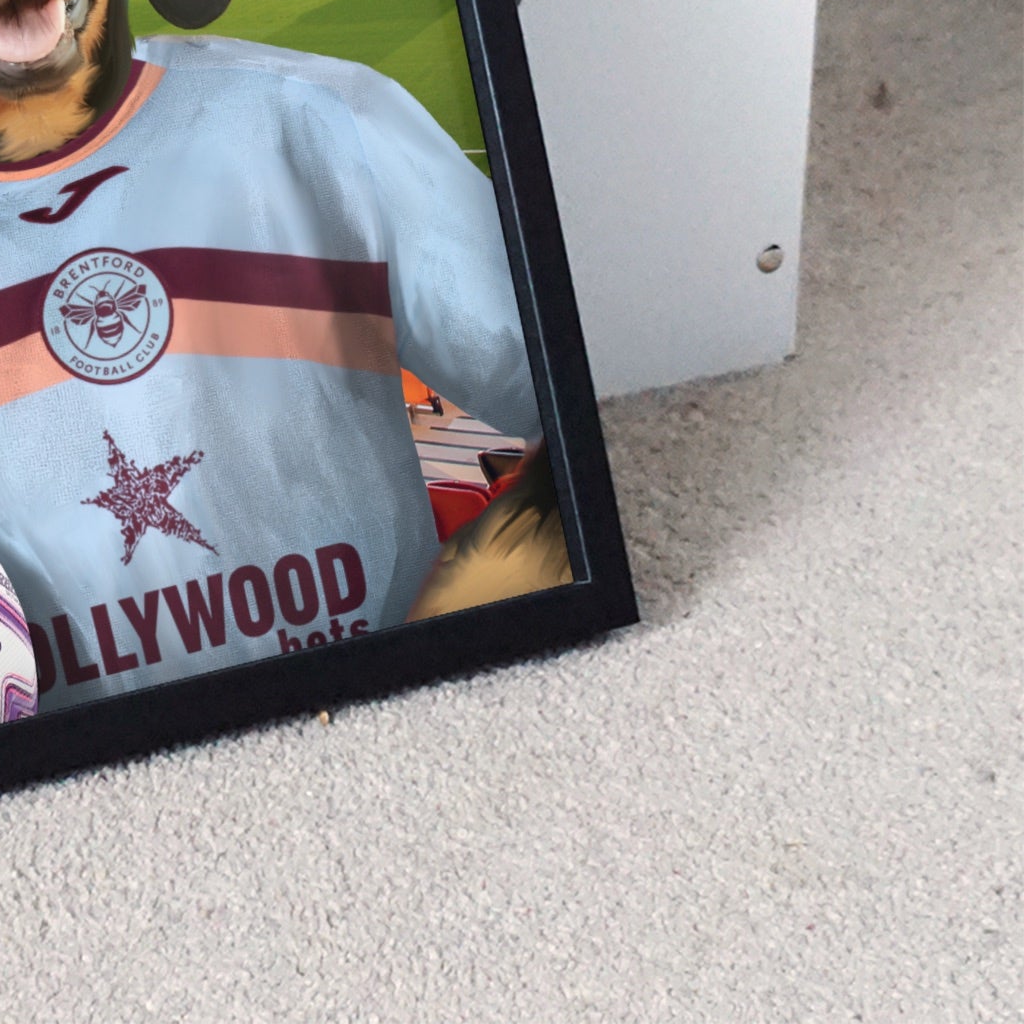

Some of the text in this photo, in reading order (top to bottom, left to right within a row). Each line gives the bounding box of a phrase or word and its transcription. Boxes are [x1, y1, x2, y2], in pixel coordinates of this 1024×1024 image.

[52, 255, 145, 299] BRENTFORD
[69, 332, 160, 376] FOOTBALL CLUB
[28, 542, 367, 695] OLLYWOOD
